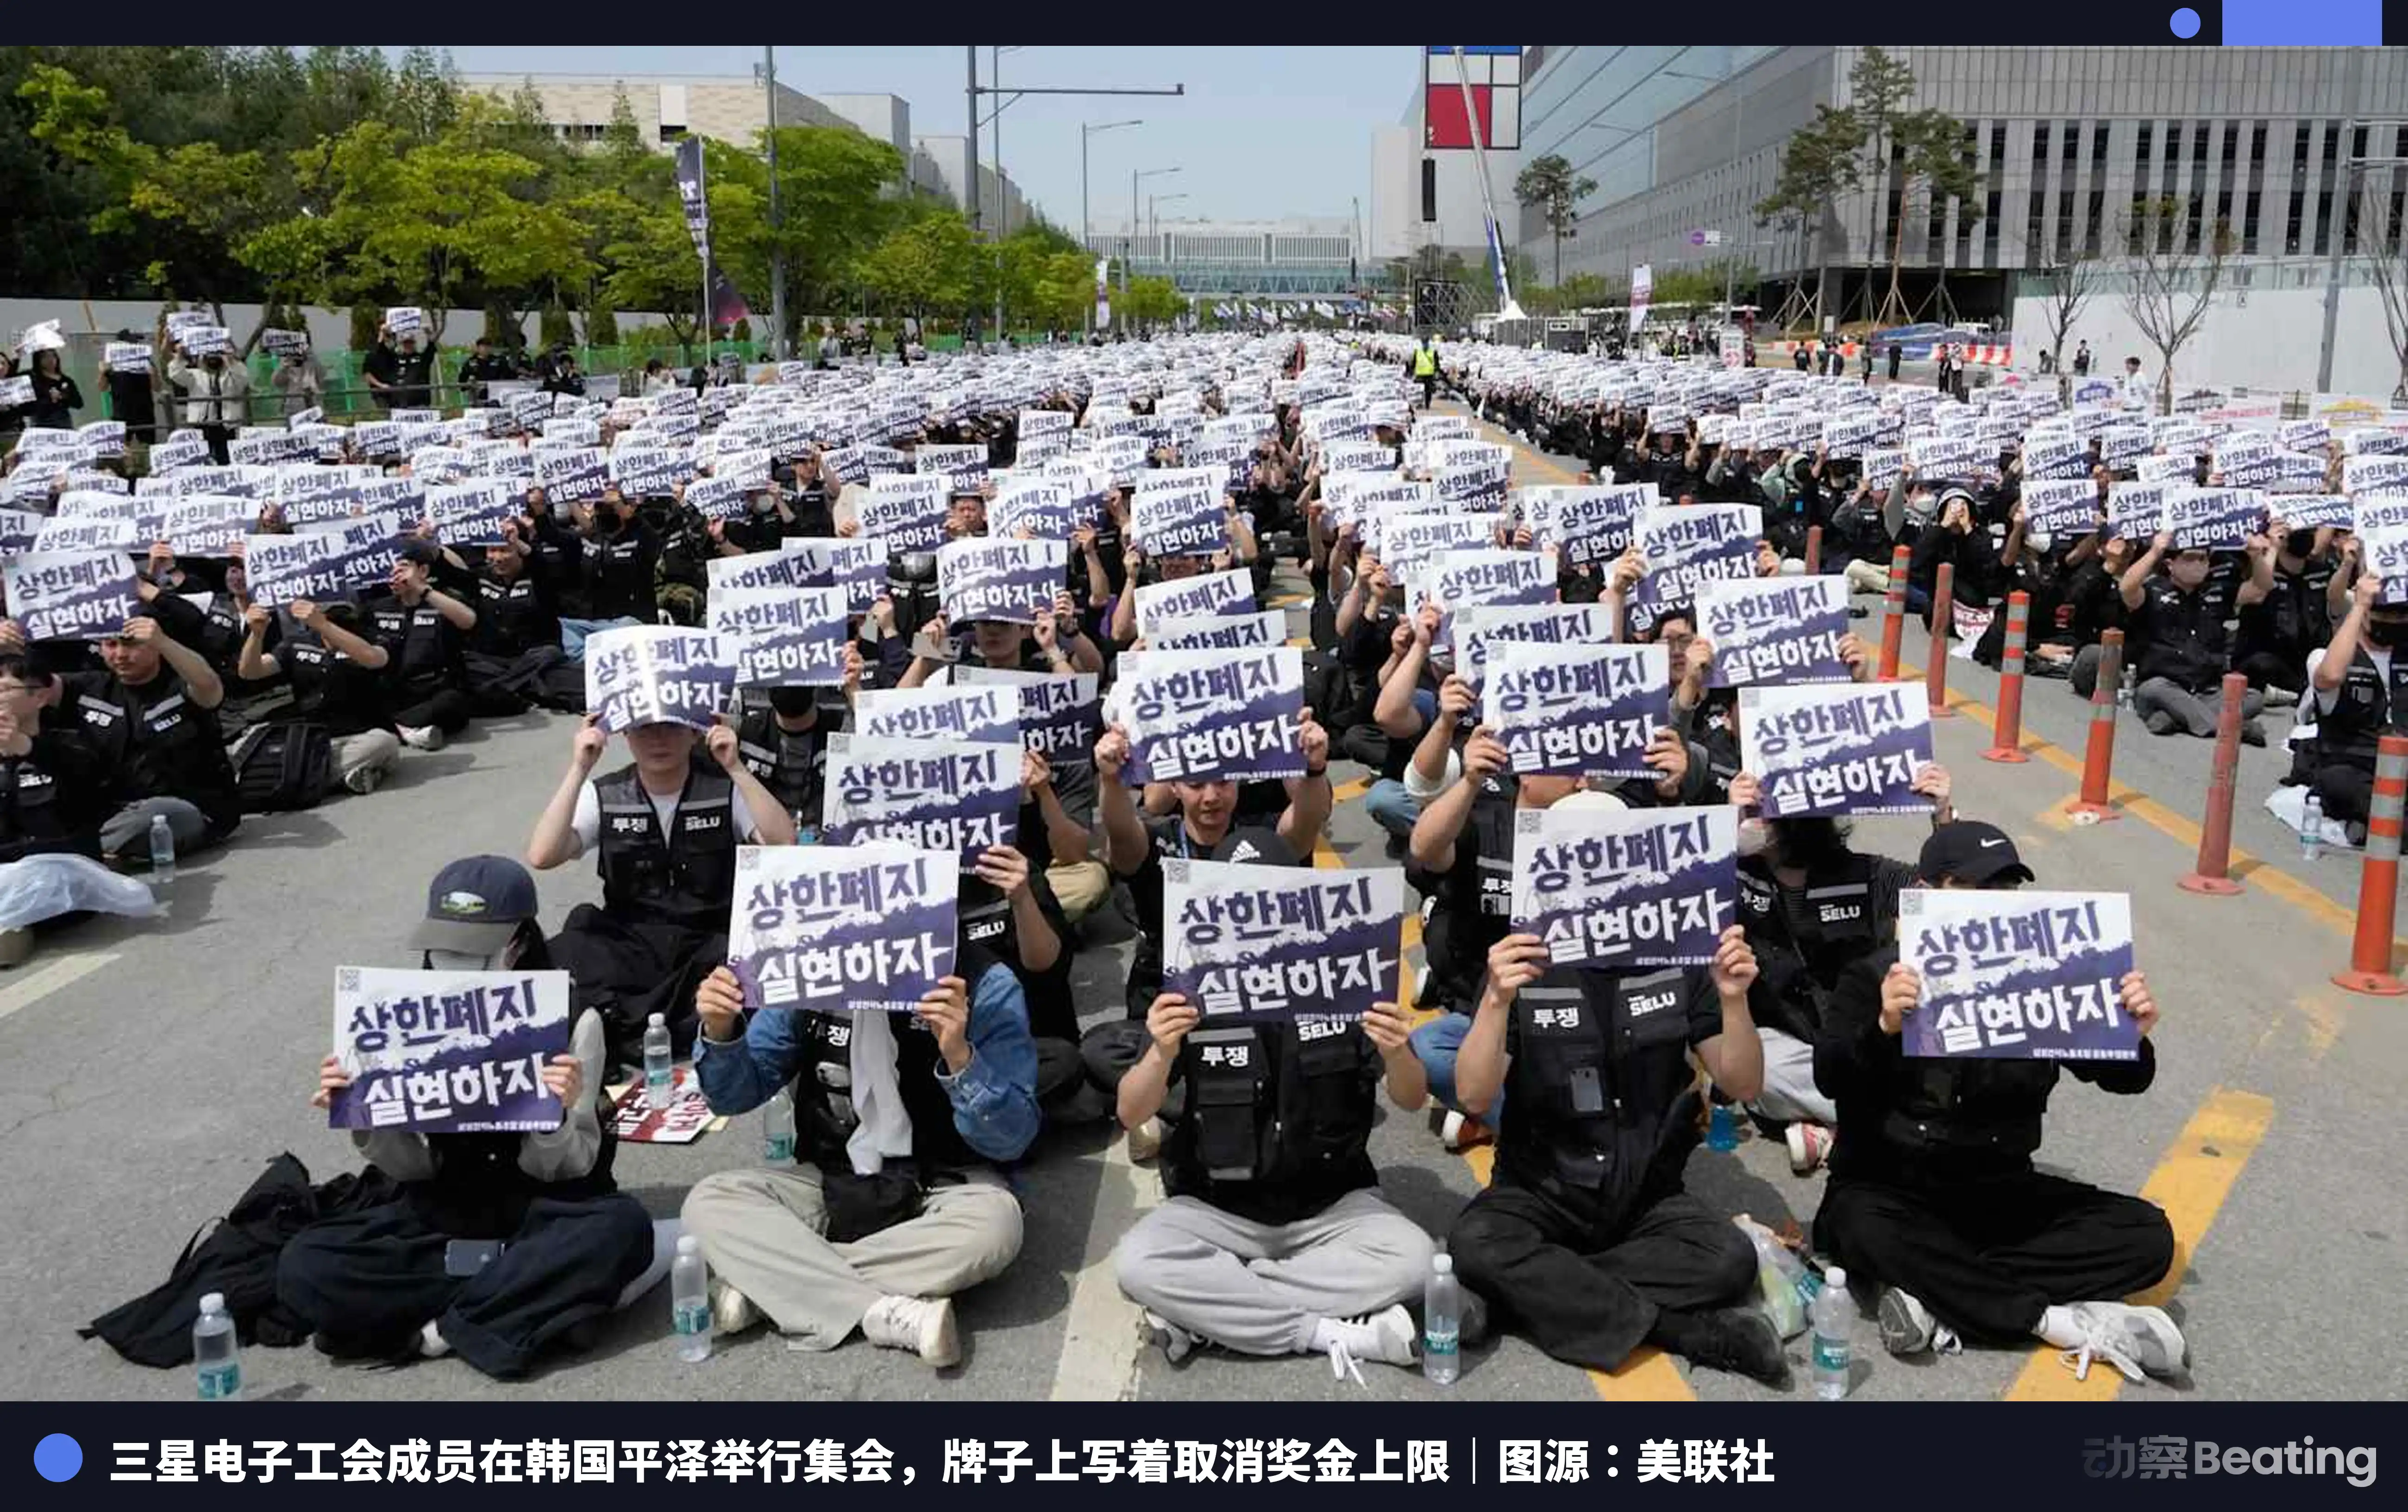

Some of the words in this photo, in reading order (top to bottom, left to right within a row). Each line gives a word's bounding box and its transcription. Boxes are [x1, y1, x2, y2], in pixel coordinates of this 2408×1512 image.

[541, 450, 598, 479] 상한폐지
[616, 450, 669, 474] 상한폐지
[922, 448, 978, 469] 상한폐지
[2026, 441, 2083, 464] 상한폐지
[2220, 445, 2273, 464] 상한폐지
[179, 469, 242, 494] 상한폐지
[281, 469, 350, 496] 상한폐지
[548, 479, 605, 503] 실현하자
[622, 473, 675, 494] 실현하자
[1437, 468, 1496, 499] 상한폐지
[2026, 482, 2088, 507] 상한폐지
[169, 499, 246, 527] 상한폐지
[285, 499, 352, 523] 실현하자
[431, 487, 495, 517] 상한폐지
[863, 496, 935, 525] 상한폐지
[1137, 490, 1212, 525] 상한폐지
[1558, 487, 1645, 528] 상한폐지
[2170, 492, 2238, 520] 상한폐지
[438, 518, 501, 545] 실현하자
[1389, 521, 1472, 552] 상한폐지
[1642, 508, 1747, 556] 상한폐지
[2033, 509, 2094, 532] 실현하자
[2176, 521, 2247, 548] 실현하자
[39, 524, 119, 552] 상한폐지
[248, 533, 330, 575] 상한폐지
[1568, 528, 1634, 562] 실현하
[344, 548, 402, 581] 현하자
[833, 544, 873, 571] 폐지
[942, 543, 1029, 585] 상한폐지
[15, 554, 119, 600] 상한폐지
[254, 570, 346, 606] 실현하자
[1440, 558, 1542, 601] 상한폐지
[26, 593, 137, 639] 실현하자
[716, 593, 829, 636] 상한폐지
[1707, 581, 1828, 635] 상한폐지
[1722, 630, 1841, 685] 실현하자
[1019, 679, 1078, 717] 폐지
[1131, 653, 1279, 721] 상한폐지
[1498, 651, 1646, 712] 상한폐지
[1019, 723, 1091, 752] 하자
[1755, 689, 1905, 755] 상한폐지
[1148, 714, 1302, 780] 실현하자
[1507, 714, 1658, 773] 실현하자
[839, 750, 996, 805] 상한폐지
[1773, 749, 1931, 815] 실현하자
[1529, 814, 1710, 892] 상한폐지
[748, 858, 926, 930] 상한폐지
[1179, 877, 1371, 945] 상한폐지
[1545, 889, 1734, 964] 실현하자
[1820, 905, 1861, 922] SELU
[968, 921, 1005, 940] SELU
[1915, 901, 2100, 976] 상한폐지
[758, 932, 952, 1005] 실현하자
[1198, 947, 1398, 1015] 실현하자
[348, 978, 537, 1053] 상한폐지
[1533, 1008, 1579, 1029] 투쟁
[1630, 996, 1676, 1016] SELU
[1937, 978, 2121, 1053] 실현하자
[828, 1026, 850, 1047] 쟁
[1298, 1022, 1346, 1042] SELU
[1202, 1046, 1248, 1067] 투쟁
[364, 1052, 550, 1127] 실현하자
